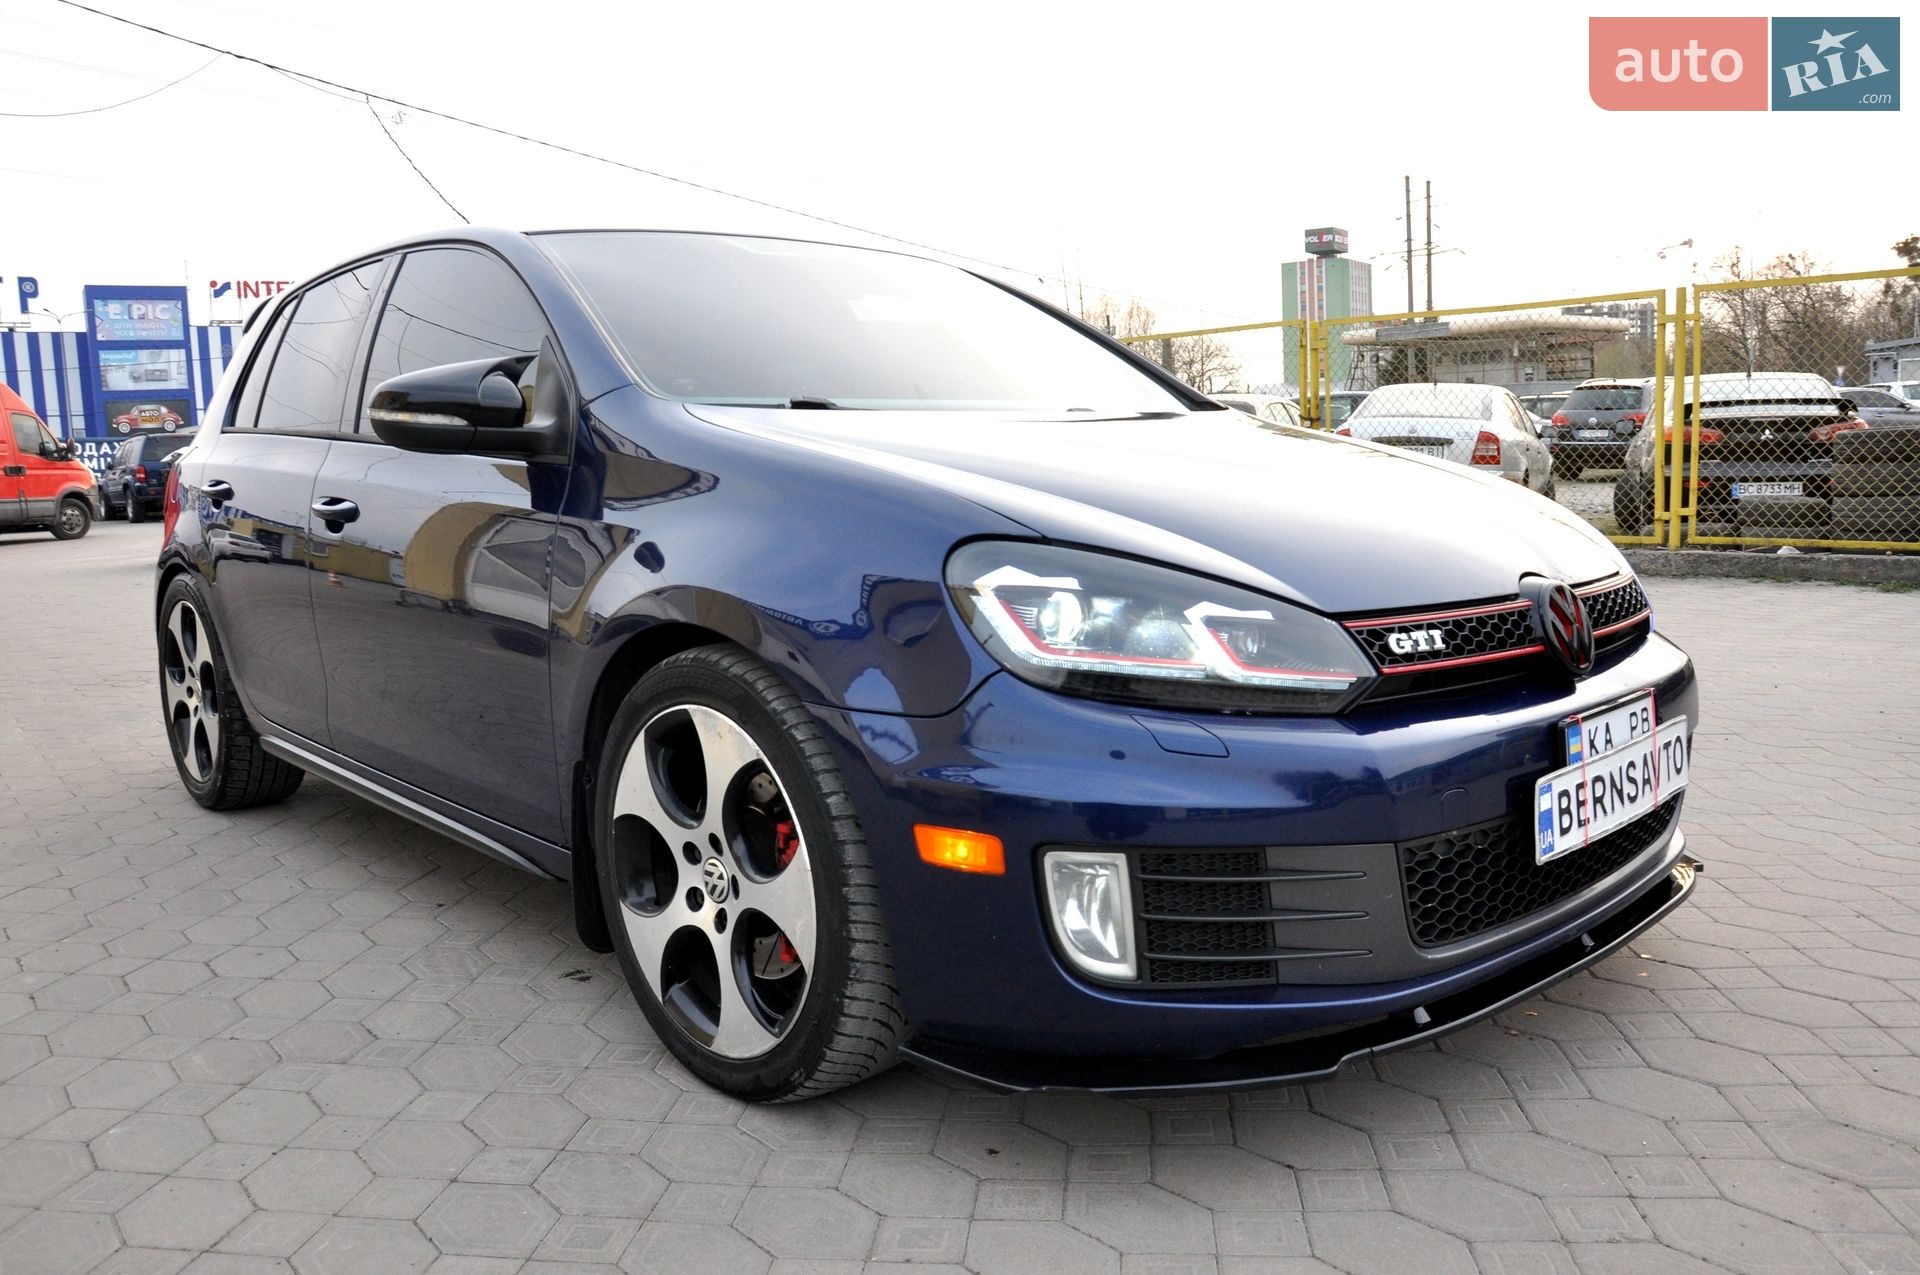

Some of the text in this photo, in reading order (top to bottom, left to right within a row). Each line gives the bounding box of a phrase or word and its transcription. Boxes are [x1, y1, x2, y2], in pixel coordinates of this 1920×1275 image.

[237, 280, 296, 299] INTE
[1387, 629, 1446, 655] GTI
[1588, 722, 1614, 757] KA
[1557, 735, 1684, 837] BERNSAVTO
[1540, 828, 1554, 849] UA
